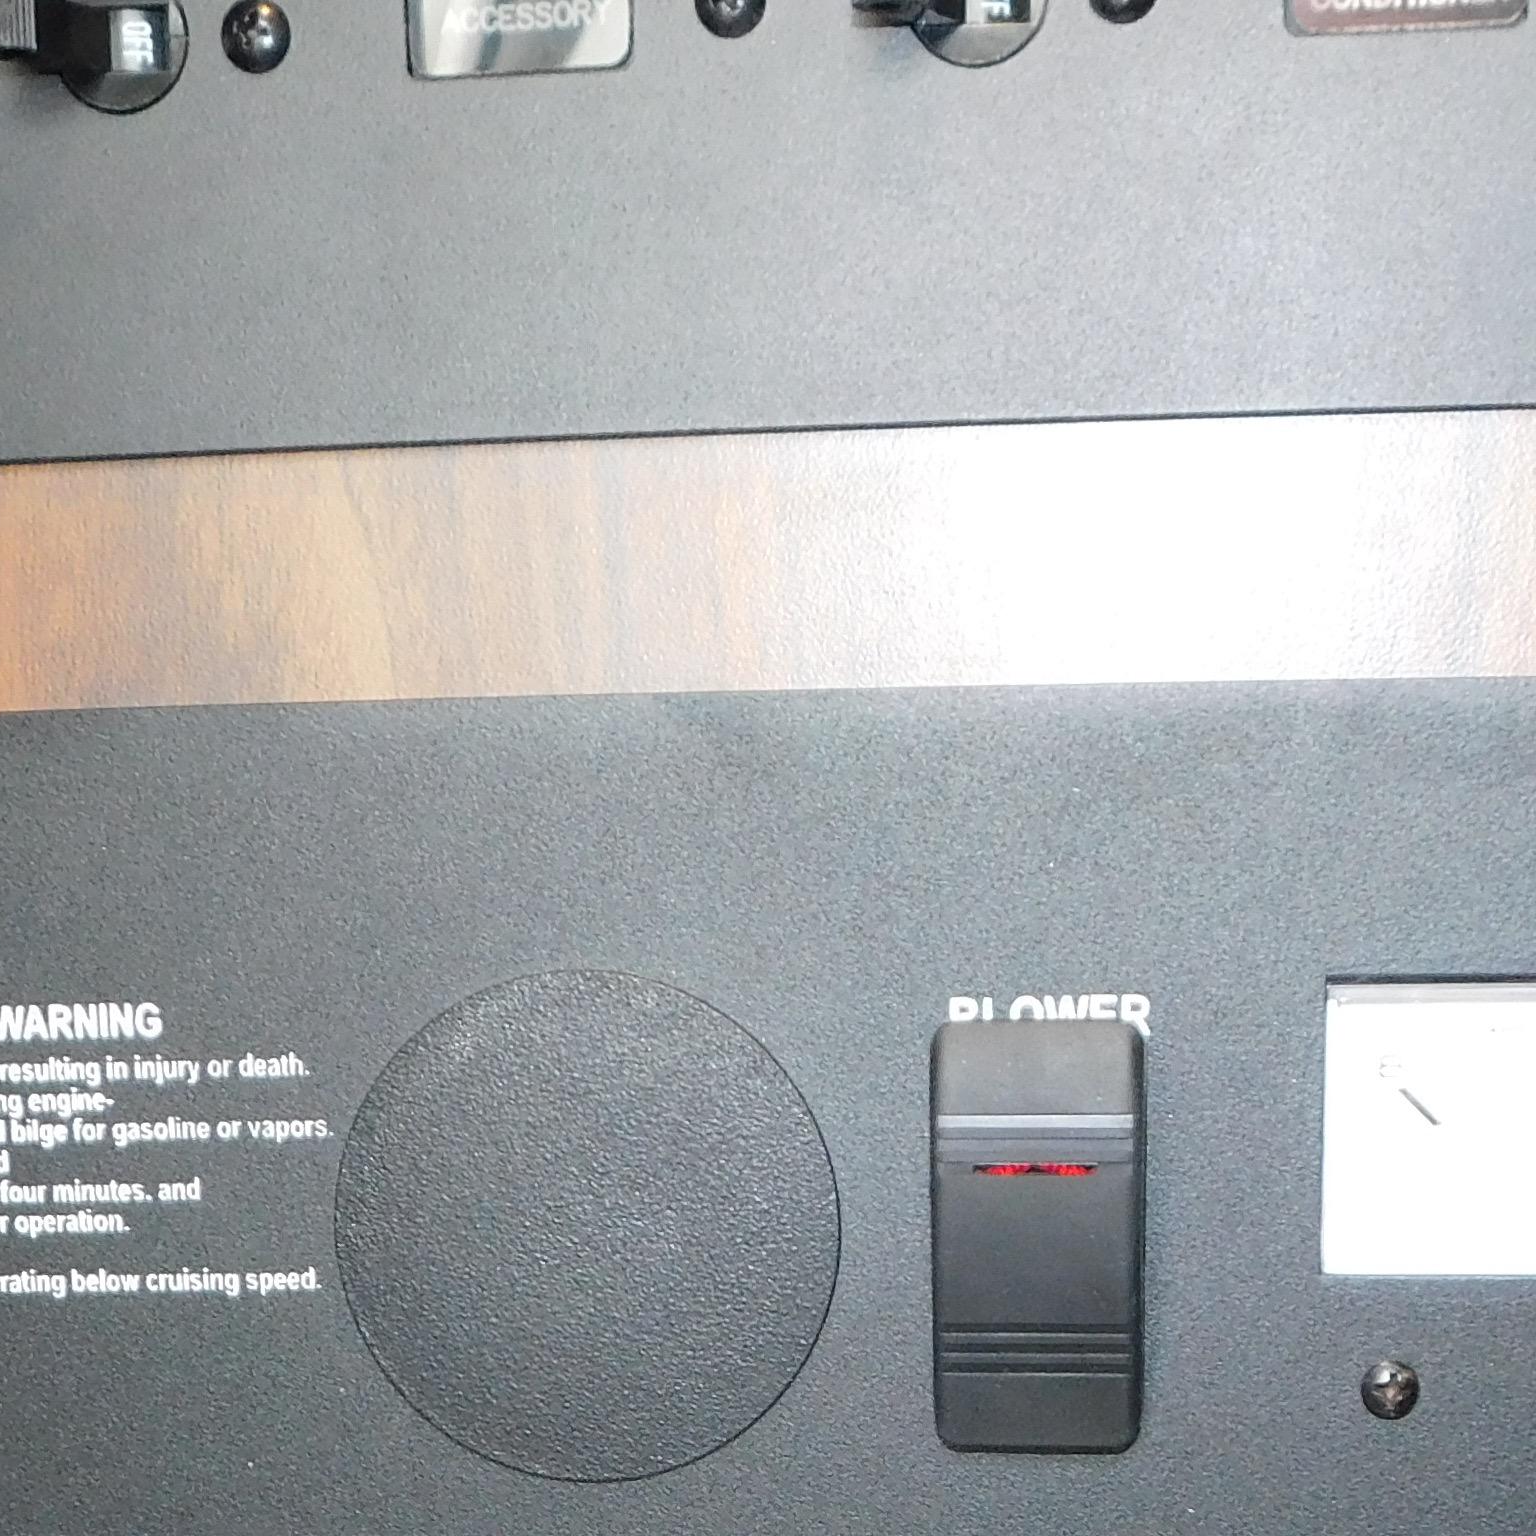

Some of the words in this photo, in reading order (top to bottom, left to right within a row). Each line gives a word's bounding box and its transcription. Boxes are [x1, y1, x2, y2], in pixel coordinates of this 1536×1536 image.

[441, 0, 609, 34] ACCESSORY
[122, 20, 154, 68] OFF
[105, 1054, 129, 1082] in
[133, 1053, 200, 1086] injury
[206, 1059, 234, 1079] or
[238, 1051, 311, 1079] death.
[27, 1087, 115, 1120] engine-
[10, 1118, 69, 1150] bilge
[72, 1117, 107, 1143] for
[111, 1116, 211, 1148] gasoline
[216, 1120, 243, 1141] or
[247, 1119, 335, 1144] vapors.
[157, 1176, 202, 1202] and
[13, 1208, 131, 1239] operation.
[70, 1267, 141, 1294] below
[145, 1266, 241, 1297] cruising
[245, 1266, 323, 1297] speed.
